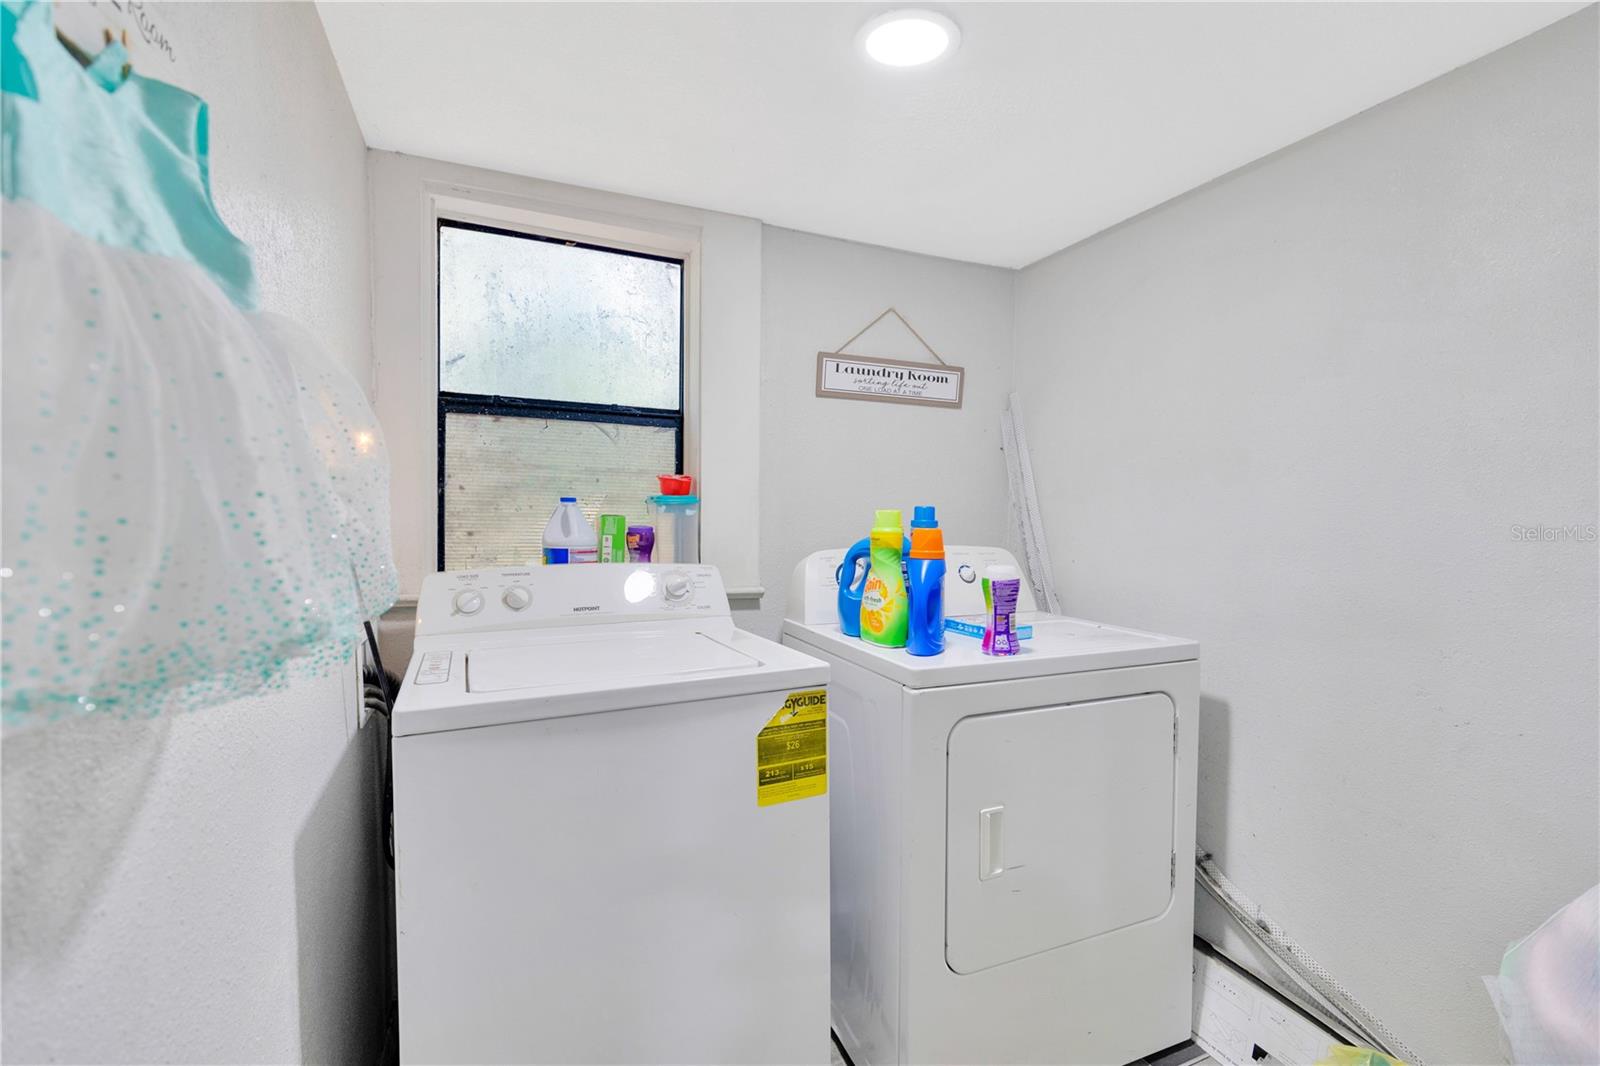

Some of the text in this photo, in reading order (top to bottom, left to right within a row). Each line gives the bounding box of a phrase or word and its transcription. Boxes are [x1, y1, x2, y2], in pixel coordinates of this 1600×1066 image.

[834, 362, 949, 384] Laundry Room
[783, 694, 826, 711] GYGUIDE
[786, 740, 800, 751] $26
